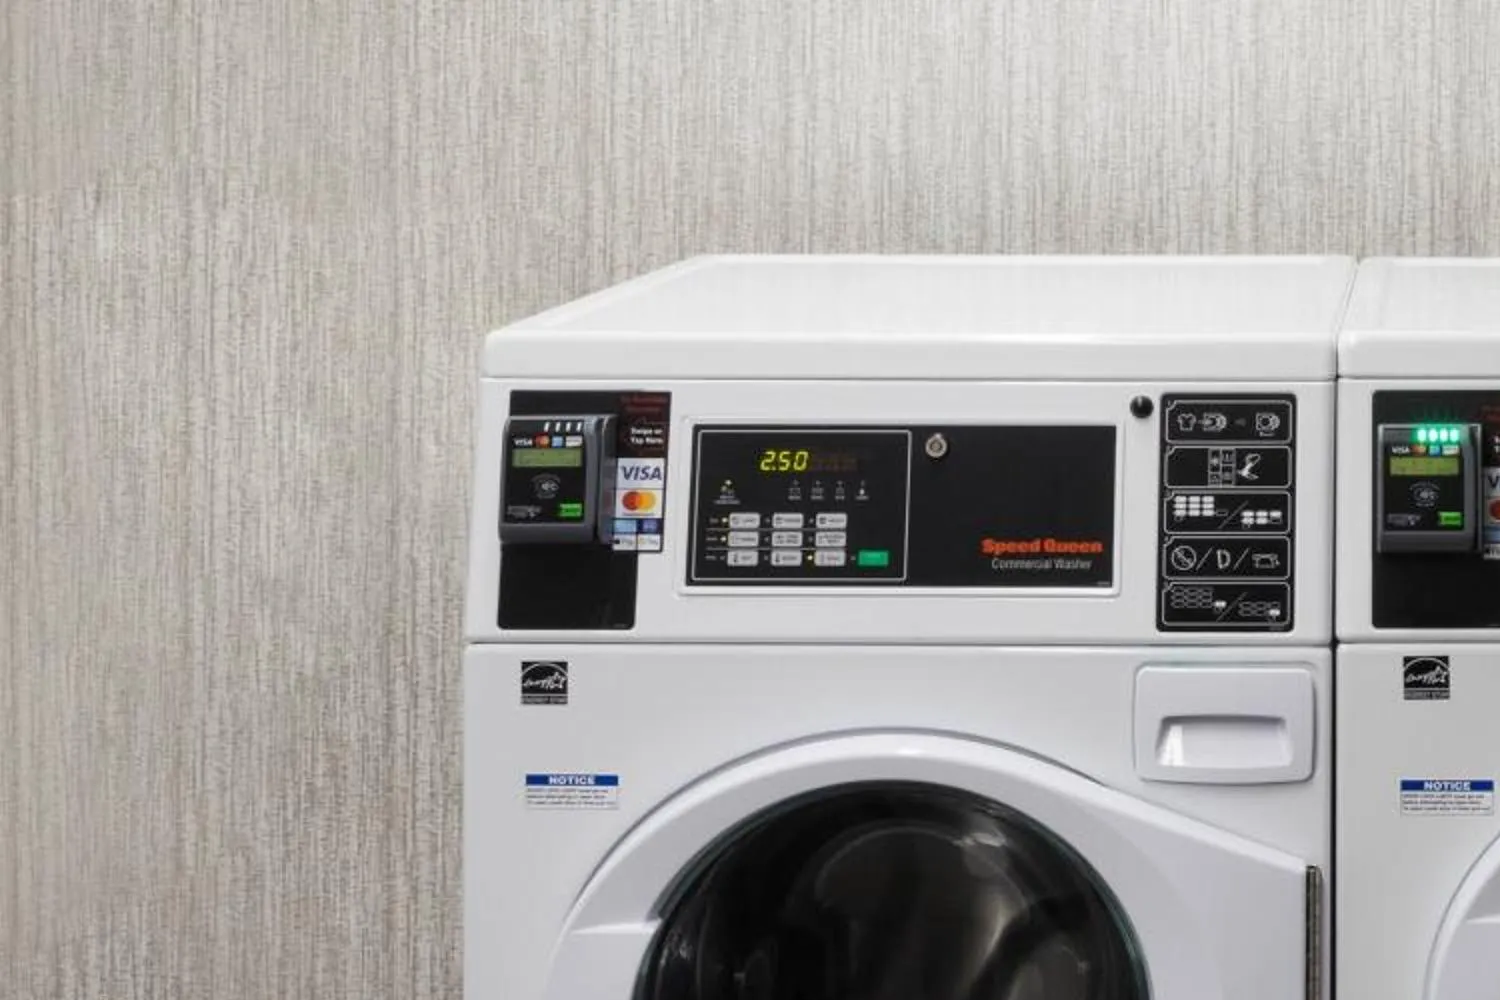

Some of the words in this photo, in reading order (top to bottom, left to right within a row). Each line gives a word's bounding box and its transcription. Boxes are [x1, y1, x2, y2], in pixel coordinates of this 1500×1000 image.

[622, 466, 662, 480] VISA
[982, 538, 1041, 555] Speed
[1043, 538, 1104, 553] Queen
[991, 557, 1052, 570] Commercial
[1053, 558, 1093, 570] Washer
[548, 775, 596, 785] NOTICE
[1423, 780, 1471, 791] NOTICE
